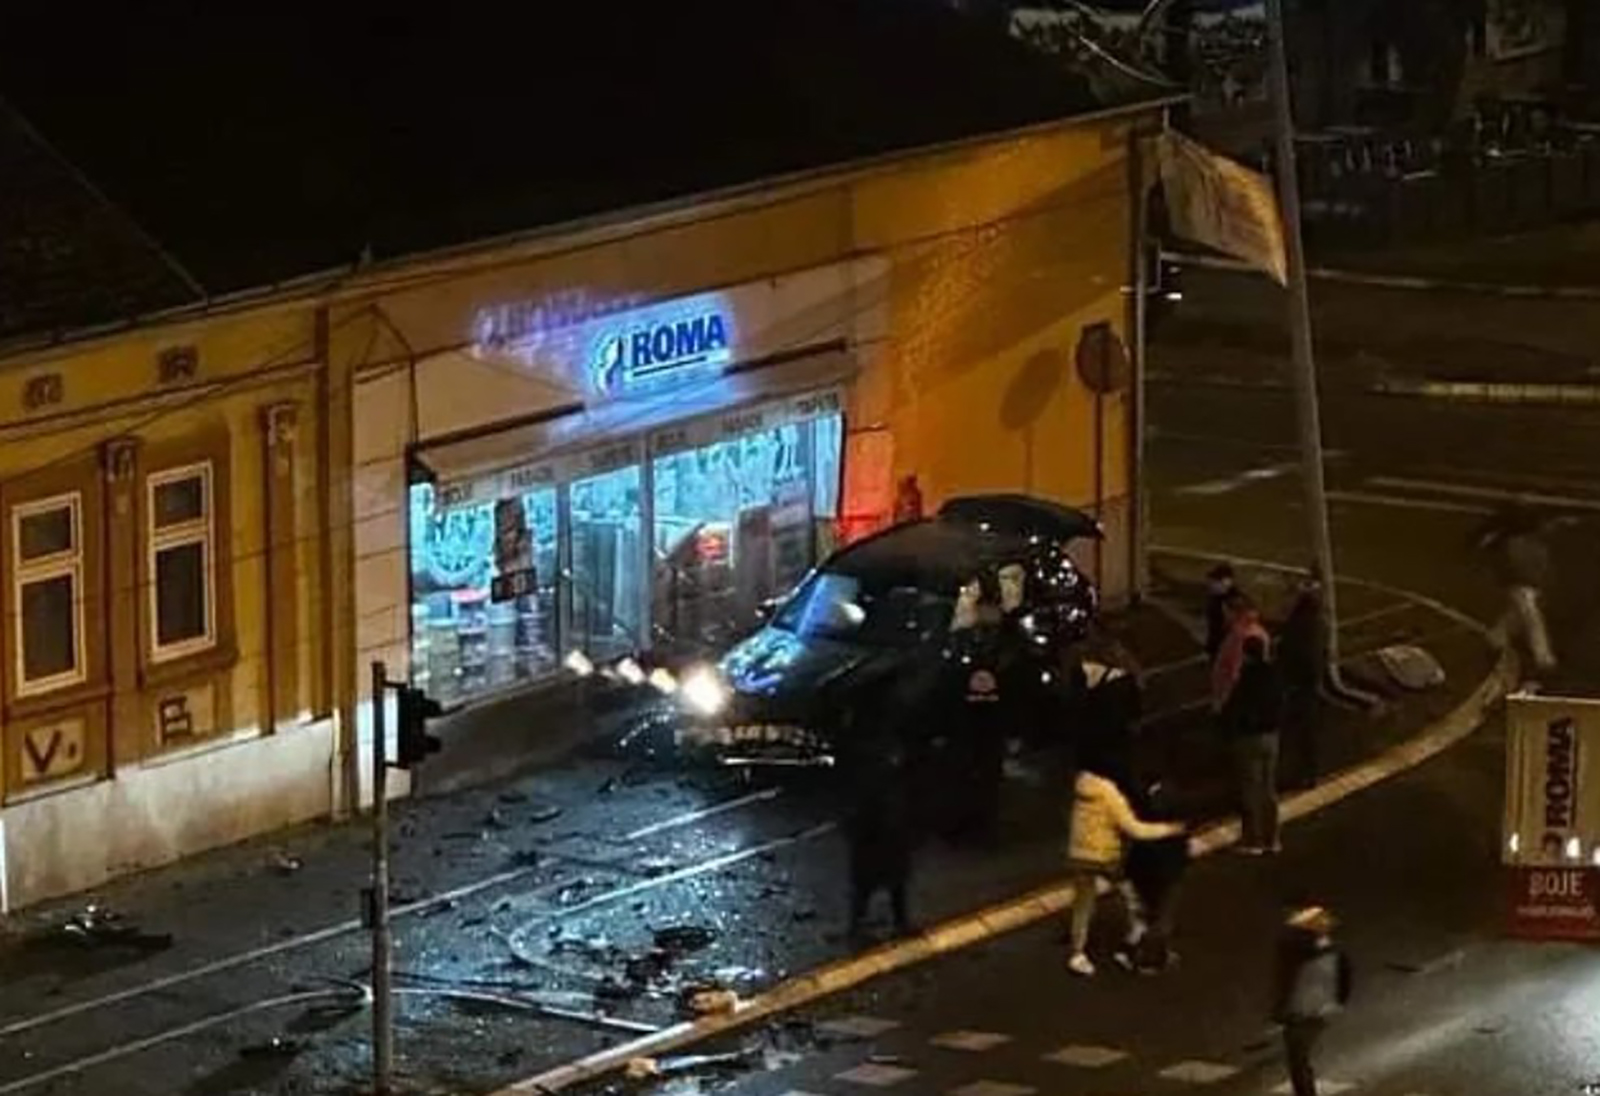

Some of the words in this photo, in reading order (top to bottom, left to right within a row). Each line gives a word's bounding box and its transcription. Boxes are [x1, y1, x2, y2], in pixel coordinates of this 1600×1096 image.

[631, 314, 727, 367] ROMA
[1546, 716, 1572, 828] ROMA
[1529, 869, 1586, 898] BOJE
